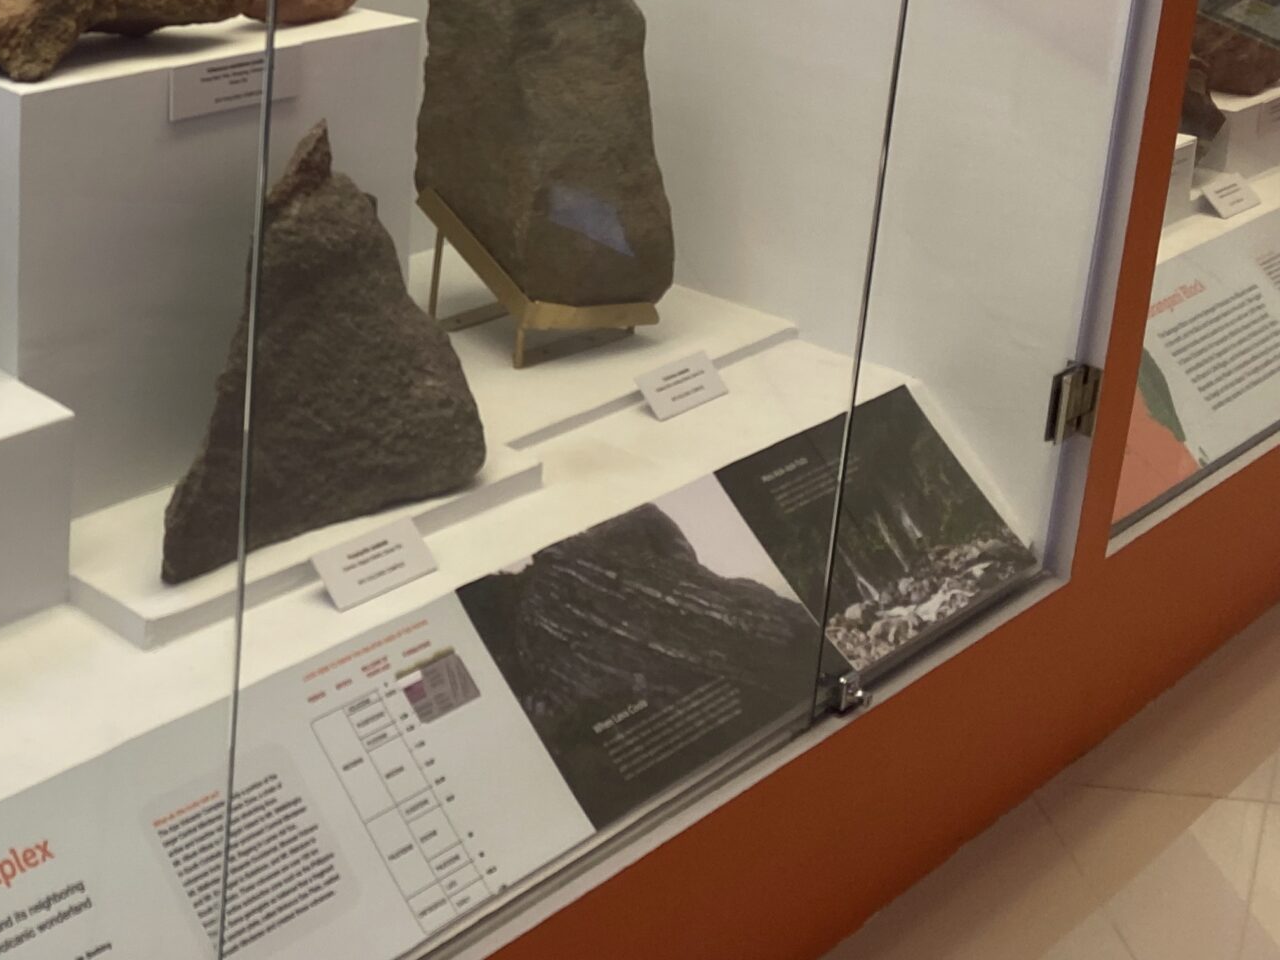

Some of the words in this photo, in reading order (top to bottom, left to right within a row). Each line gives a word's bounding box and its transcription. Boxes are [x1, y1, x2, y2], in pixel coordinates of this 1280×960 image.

[13, 910, 28, 923] its
[28, 880, 86, 912] neighboring
[36, 897, 93, 933] wonderland
